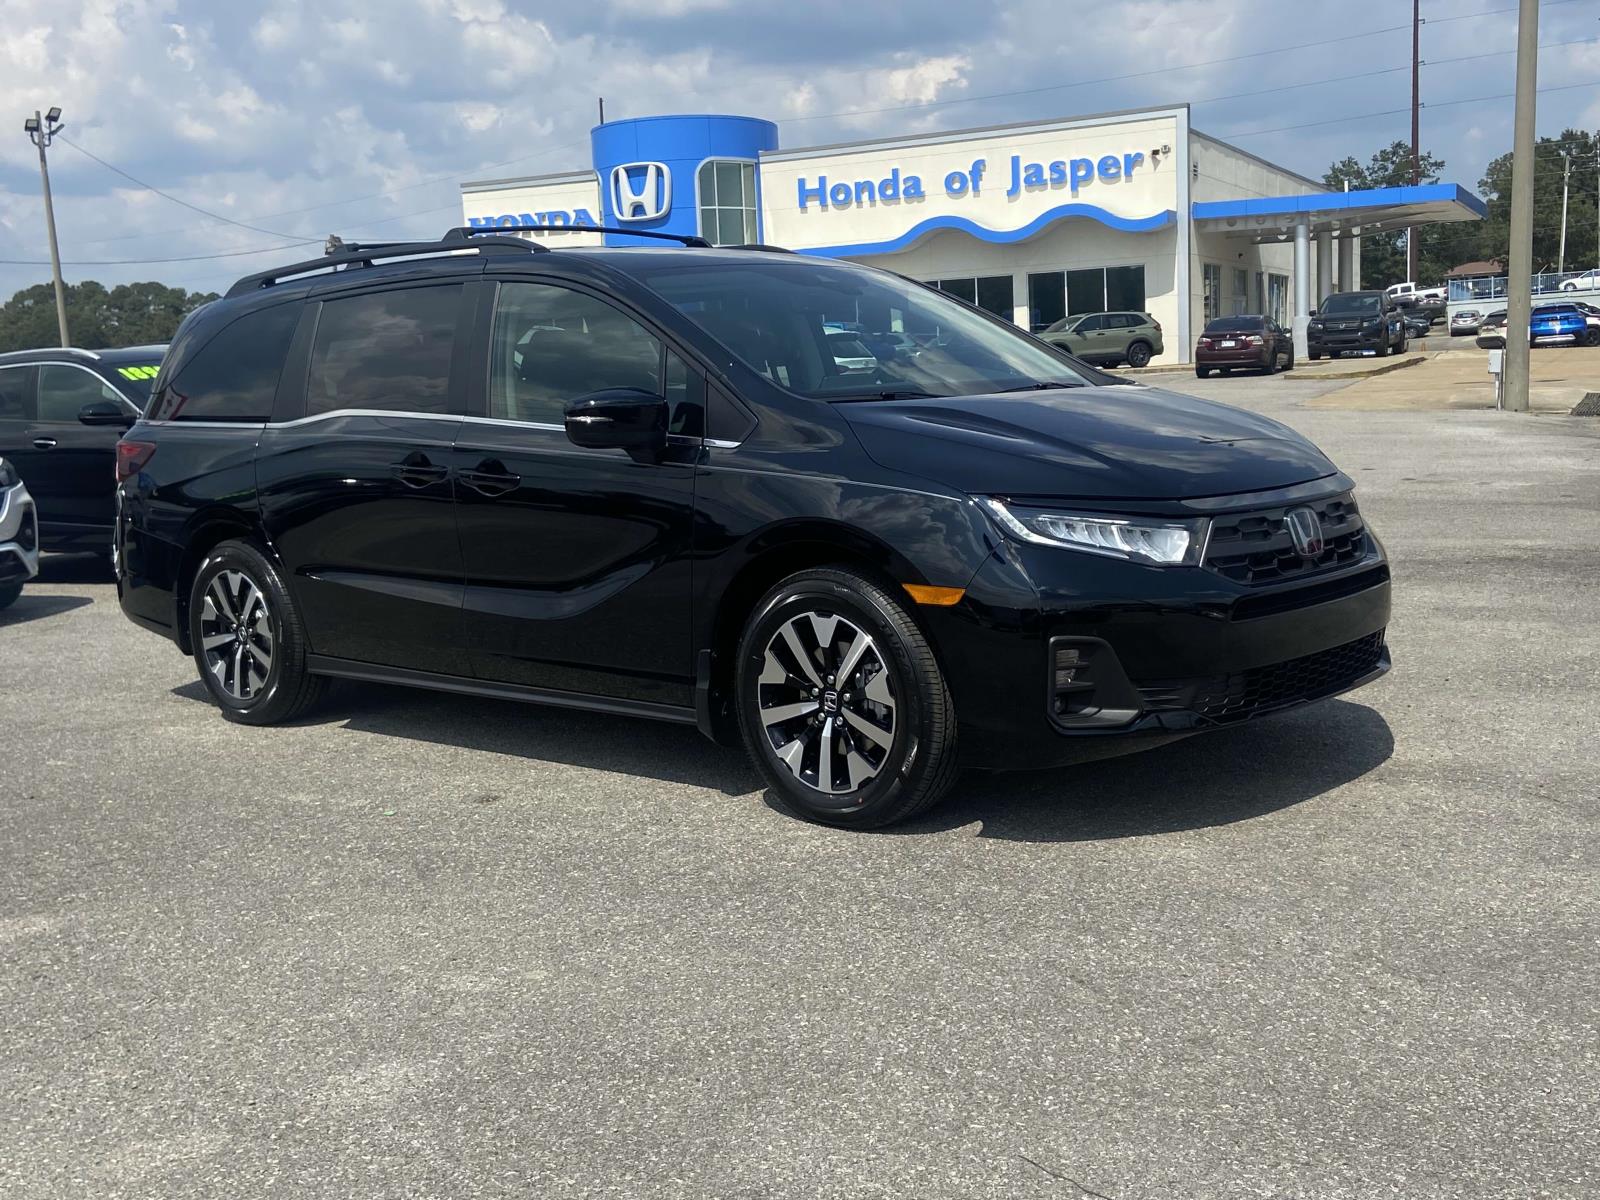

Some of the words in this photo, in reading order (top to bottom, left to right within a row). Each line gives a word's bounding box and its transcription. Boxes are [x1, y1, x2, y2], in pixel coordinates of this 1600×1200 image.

[798, 168, 924, 209] Honda
[944, 159, 986, 195] of
[1006, 150, 1145, 197] Jasper
[468, 209, 599, 237] HONDA
